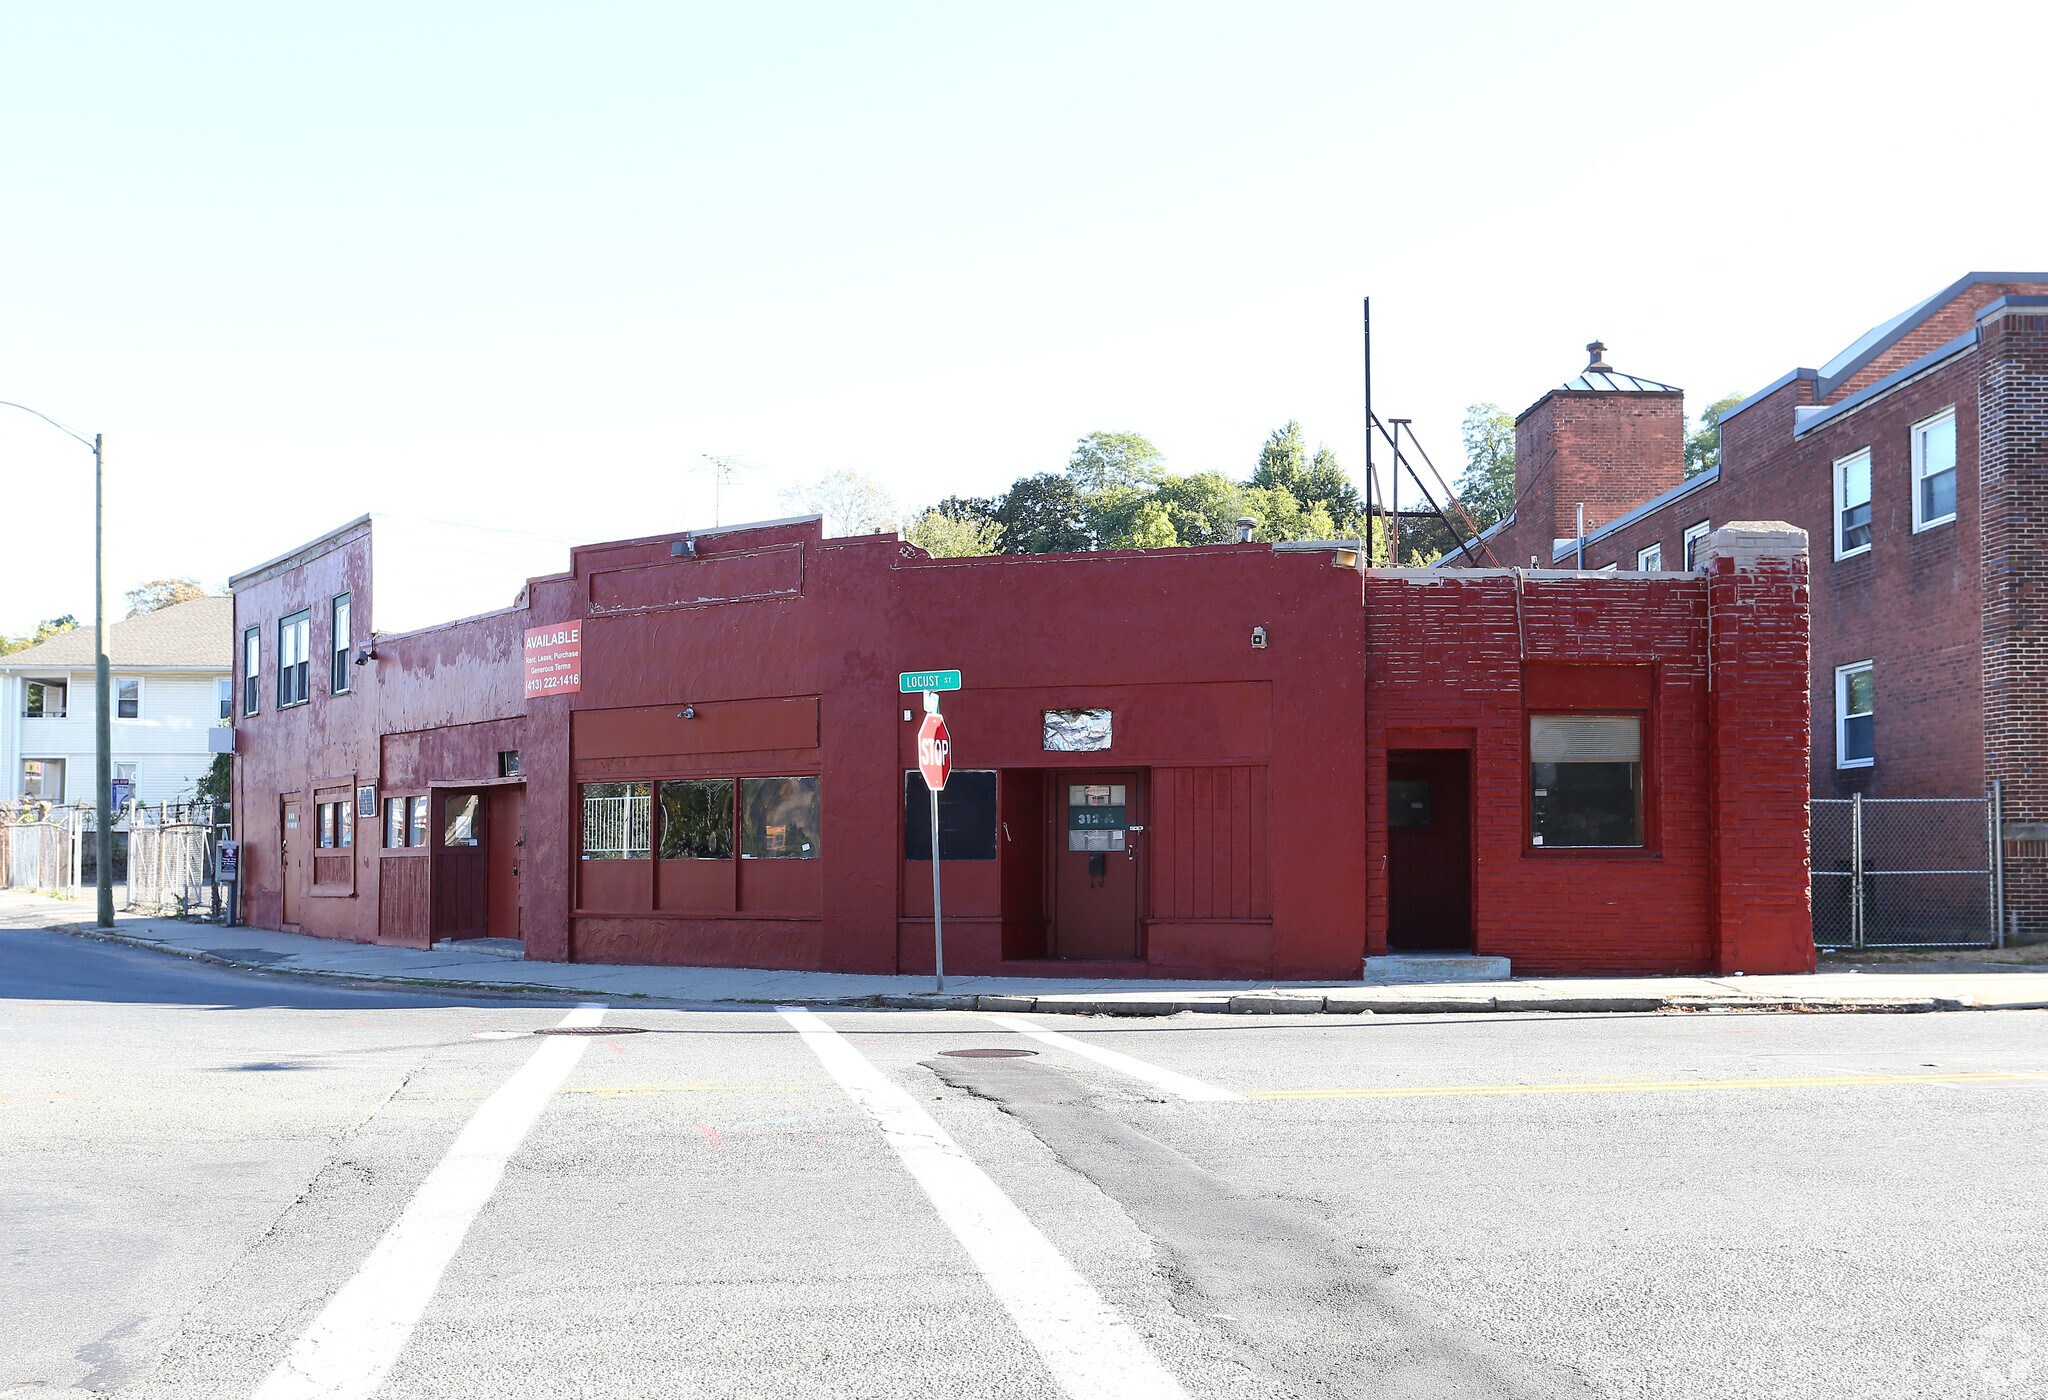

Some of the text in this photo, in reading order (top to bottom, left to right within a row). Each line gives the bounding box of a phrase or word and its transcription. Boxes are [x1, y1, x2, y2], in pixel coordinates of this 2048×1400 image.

[525, 629, 579, 650] AVAILABLE
[554, 650, 579, 659] Purchase
[530, 663, 571, 674] Generous Terms
[525, 674, 579, 693] (413) 222-1416
[906, 675, 939, 688] LOCUST
[921, 738, 949, 766] STOP
